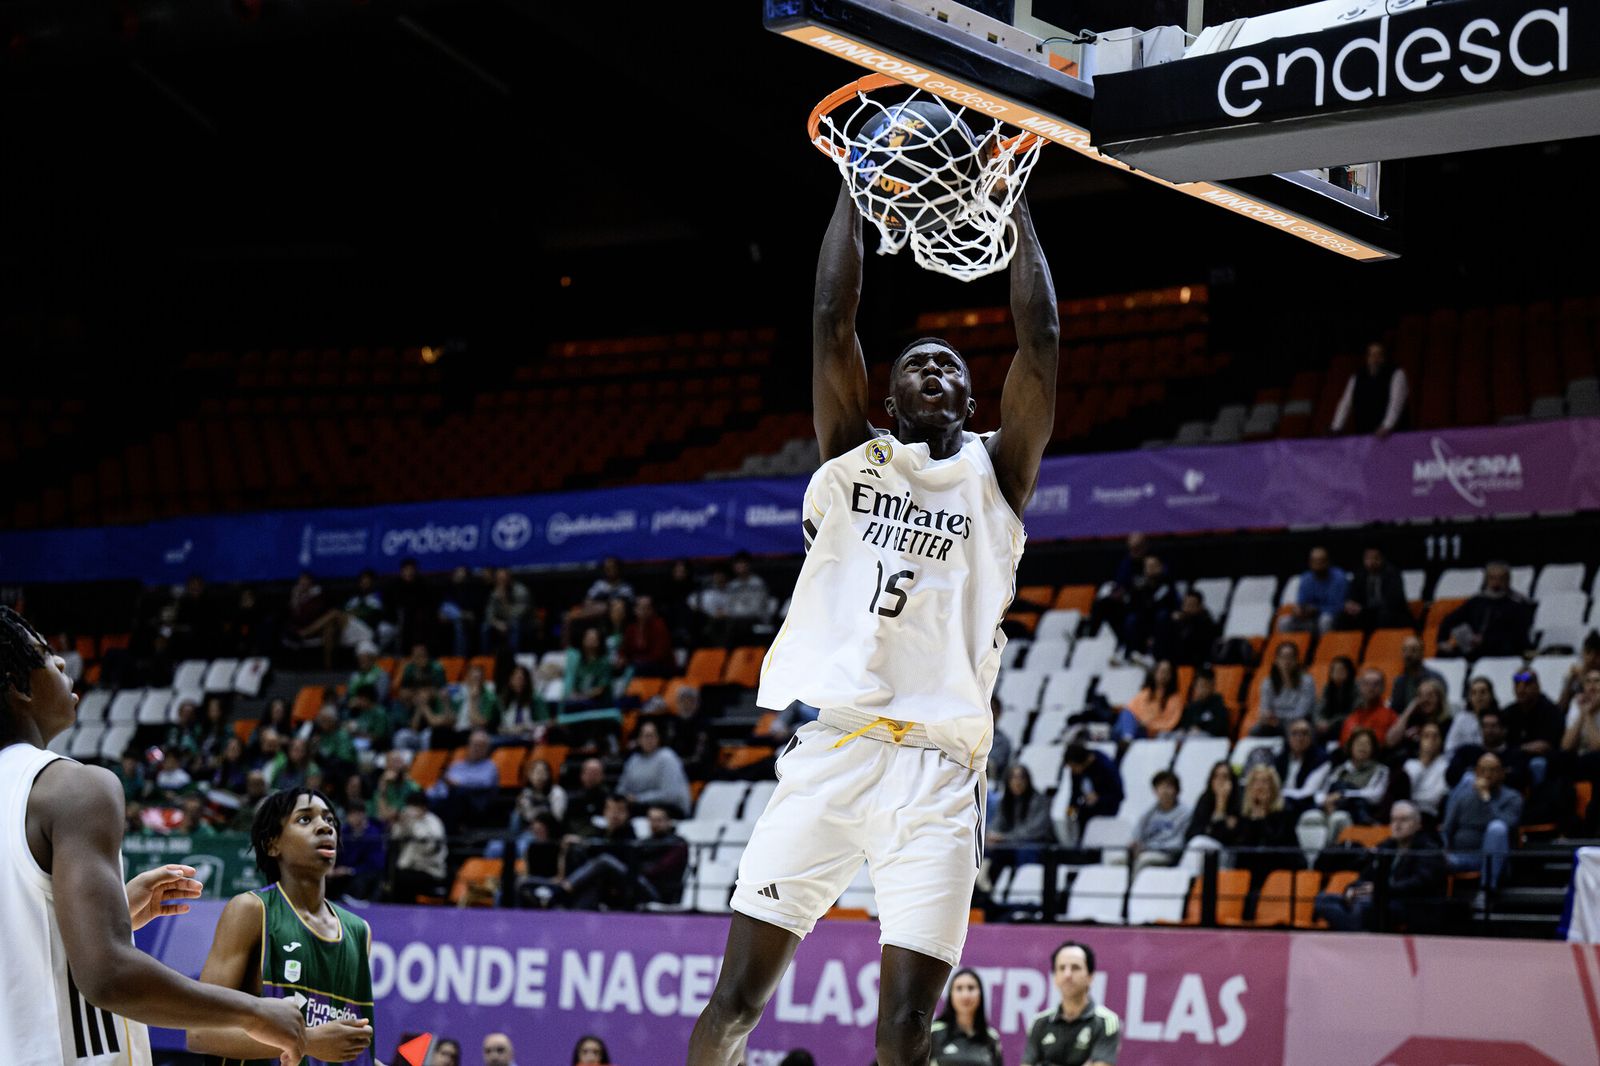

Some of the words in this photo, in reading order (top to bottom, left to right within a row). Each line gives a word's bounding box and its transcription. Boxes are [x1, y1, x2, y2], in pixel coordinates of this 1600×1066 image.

[810, 34, 930, 83] MINICOPA
[924, 79, 1009, 114] endesa
[1217, 6, 1569, 118] endesa
[1200, 189, 1294, 228] MINICOPA
[1290, 224, 1358, 254] endesa
[851, 481, 973, 540] Emirates
[862, 520, 895, 549] FLY
[892, 526, 954, 562] BETTER
[1425, 533, 1462, 560] 111
[868, 559, 915, 618] 15
[370, 941, 549, 1009] DONDE
[558, 949, 726, 1018] NACE
[774, 959, 881, 1028] LAS
